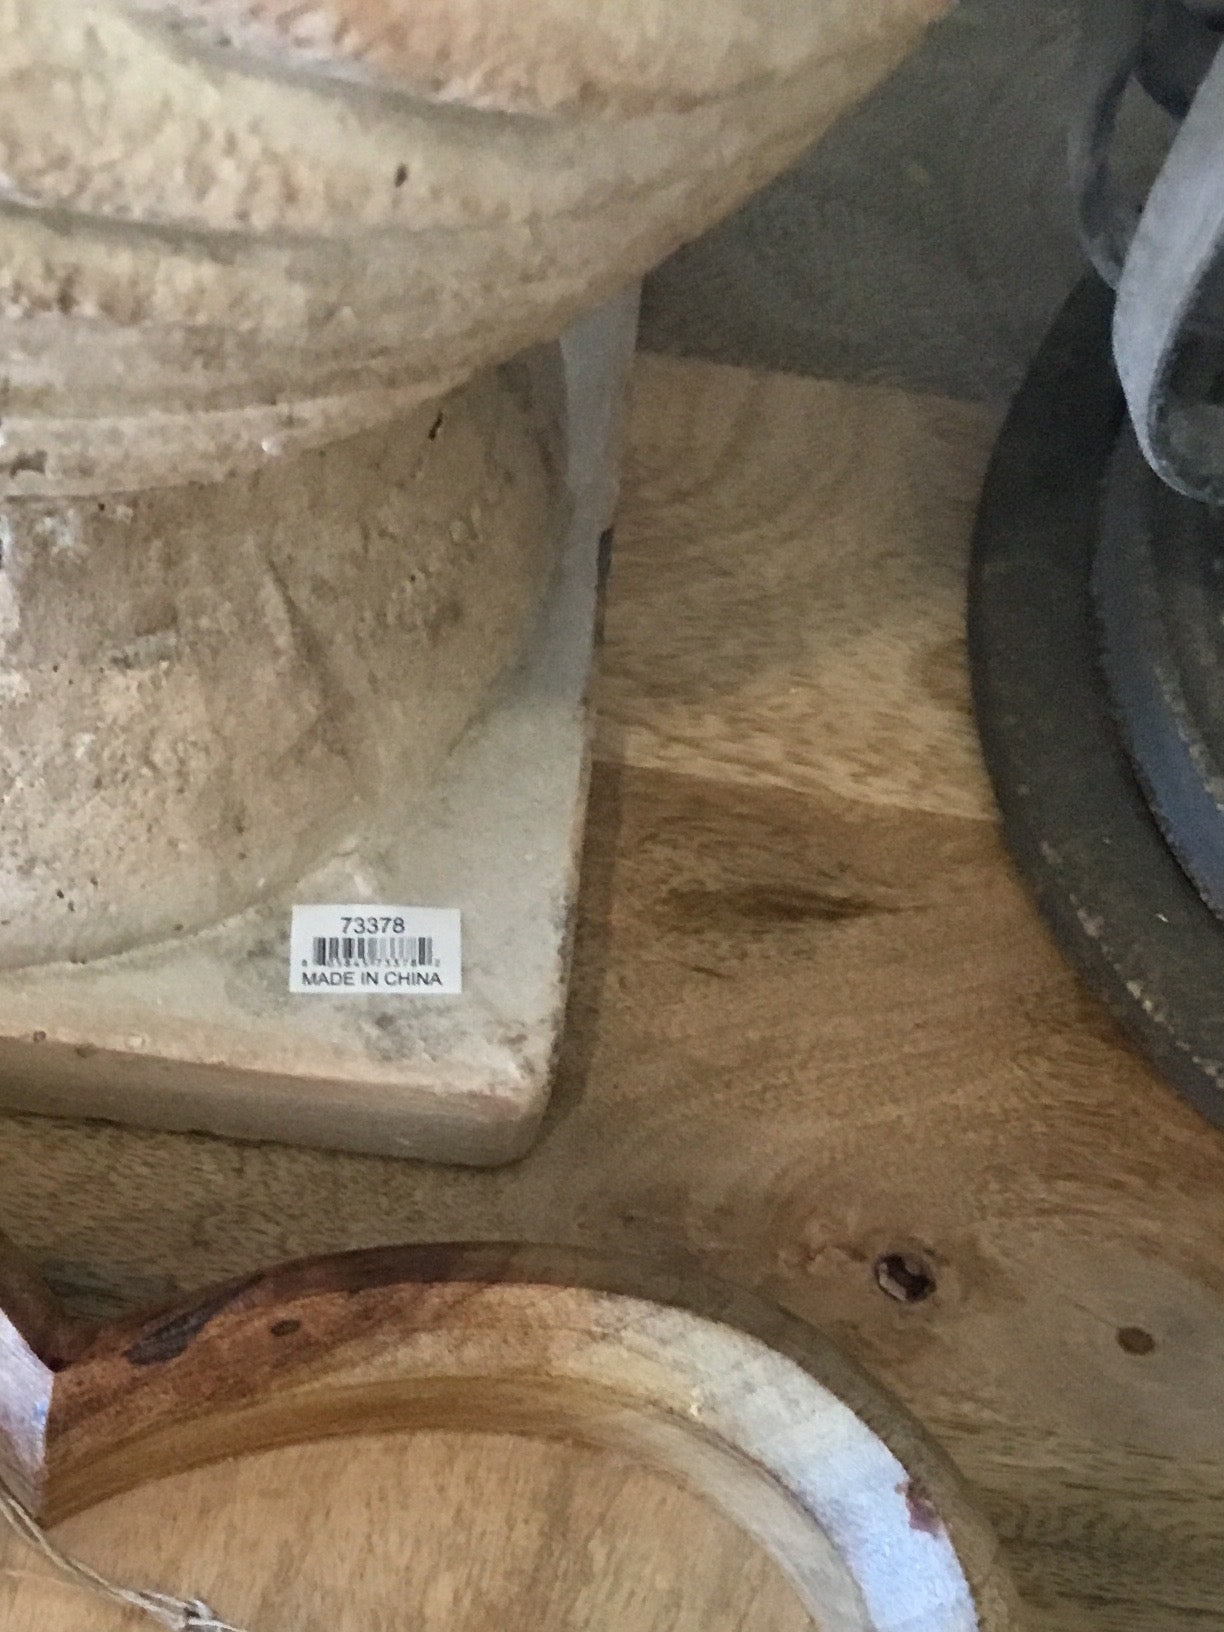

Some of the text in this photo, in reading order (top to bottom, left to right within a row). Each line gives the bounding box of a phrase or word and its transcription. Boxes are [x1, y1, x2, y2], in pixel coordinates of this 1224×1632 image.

[341, 917, 405, 934] 73378
[302, 972, 443, 986] MADE IN CHINA
